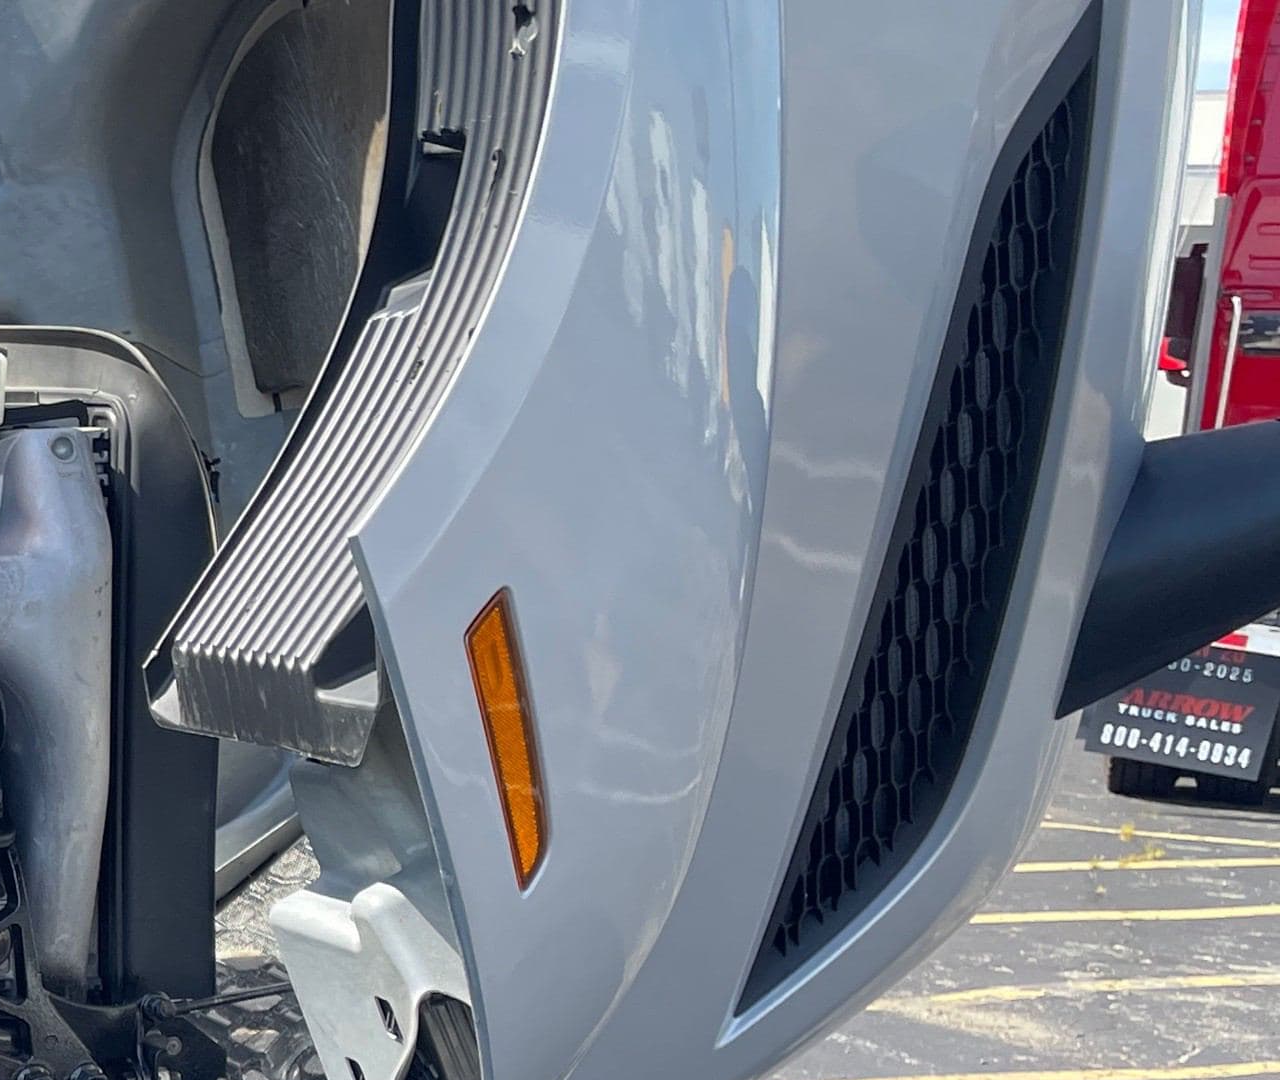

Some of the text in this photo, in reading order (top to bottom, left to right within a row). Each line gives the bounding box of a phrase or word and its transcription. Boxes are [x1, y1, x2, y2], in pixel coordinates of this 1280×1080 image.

[1117, 702, 1244, 734] TRUCK SALES
[1122, 687, 1256, 723] ARROW
